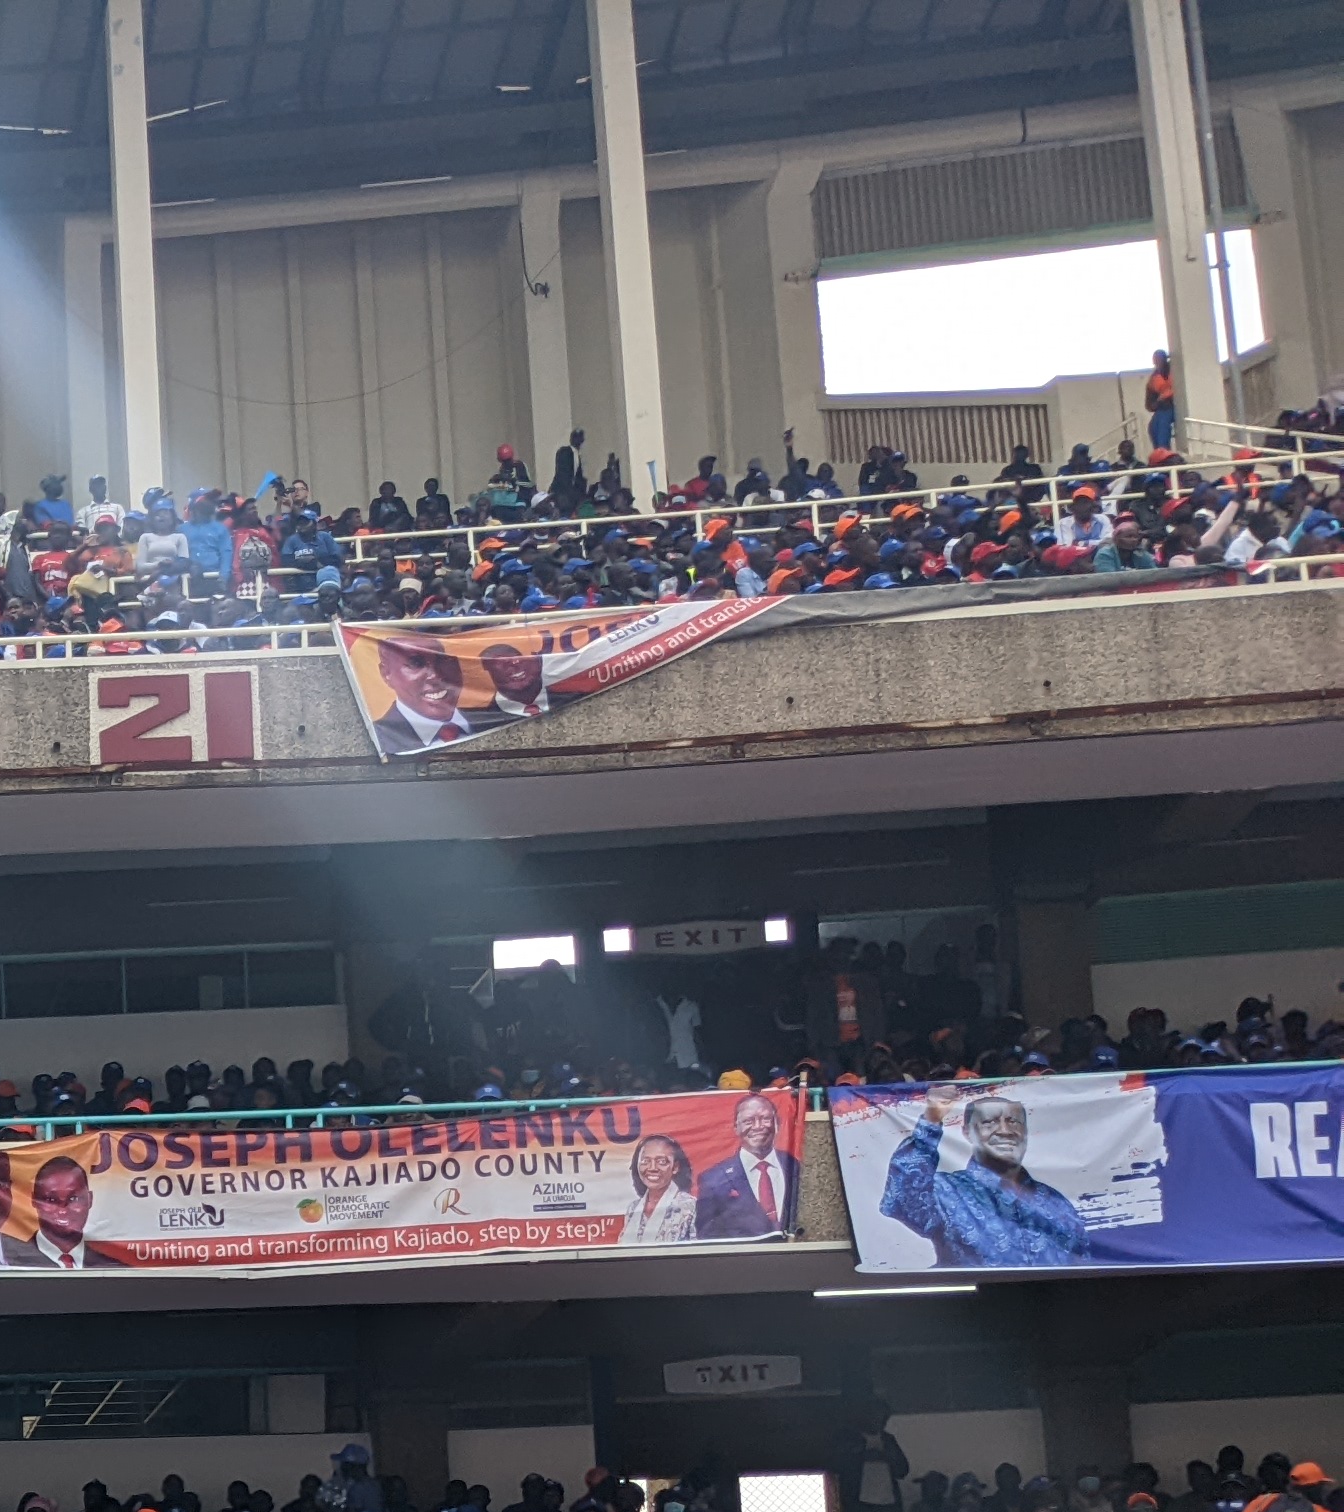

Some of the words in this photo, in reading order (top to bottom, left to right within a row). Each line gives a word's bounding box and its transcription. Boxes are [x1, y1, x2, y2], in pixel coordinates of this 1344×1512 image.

[664, 622, 702, 650] and
[98, 670, 254, 763] 21
[654, 927, 749, 949] EXIT
[90, 1131, 313, 1175] JOSEPH
[129, 1168, 308, 1198] GOVERNOR
[319, 1157, 461, 1189] KAJIADO
[474, 1150, 607, 1178] COUNTY
[327, 1194, 368, 1205] ORANGE
[532, 1182, 585, 1195] AZIMIO
[328, 1200, 391, 1213] DEMOCRATIC
[329, 1209, 385, 1221] MOVEMENT
[215, 1237, 253, 1257] and
[258, 1233, 389, 1256] transforming
[393, 1225, 475, 1252] Kajiado,
[478, 1223, 521, 1246] step
[526, 1221, 551, 1244] by
